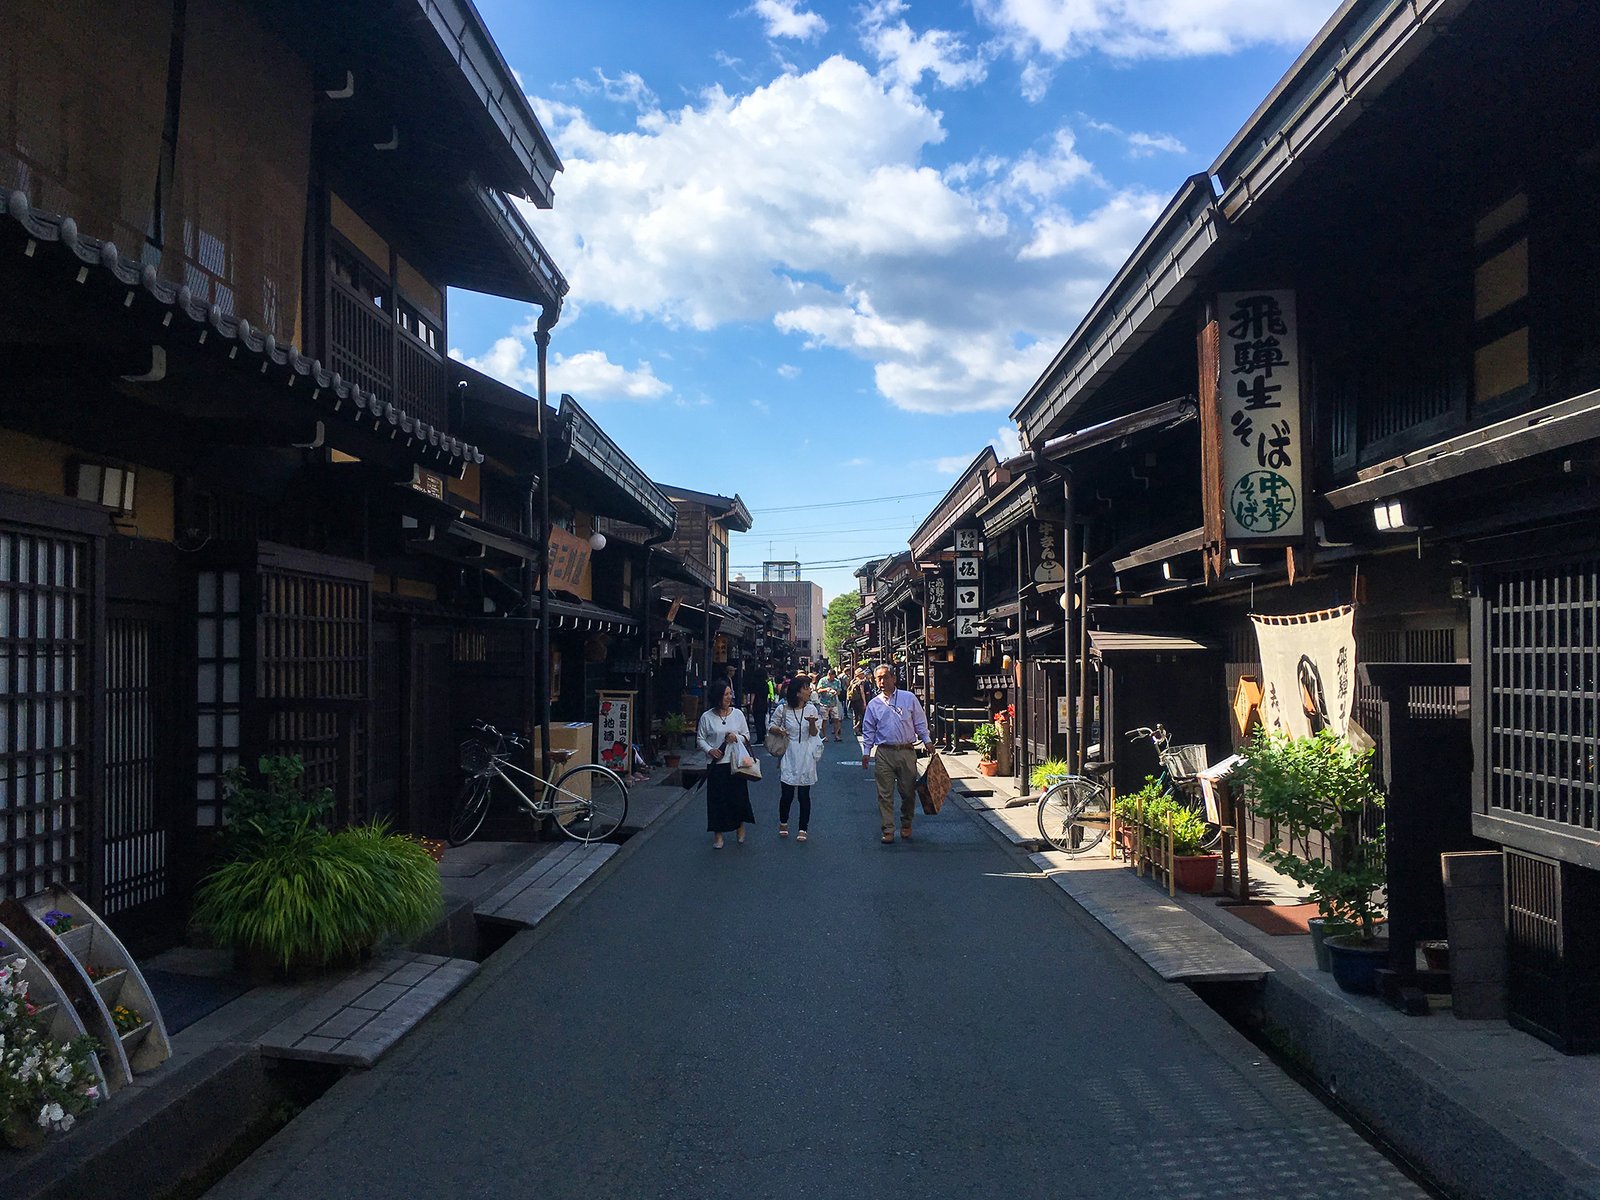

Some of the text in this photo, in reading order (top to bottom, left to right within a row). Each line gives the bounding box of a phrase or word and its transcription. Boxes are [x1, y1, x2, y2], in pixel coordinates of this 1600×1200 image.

[1236, 476, 1258, 527] そば
[1259, 474, 1291, 530] 中華
[603, 718, 615, 741] 地酒
